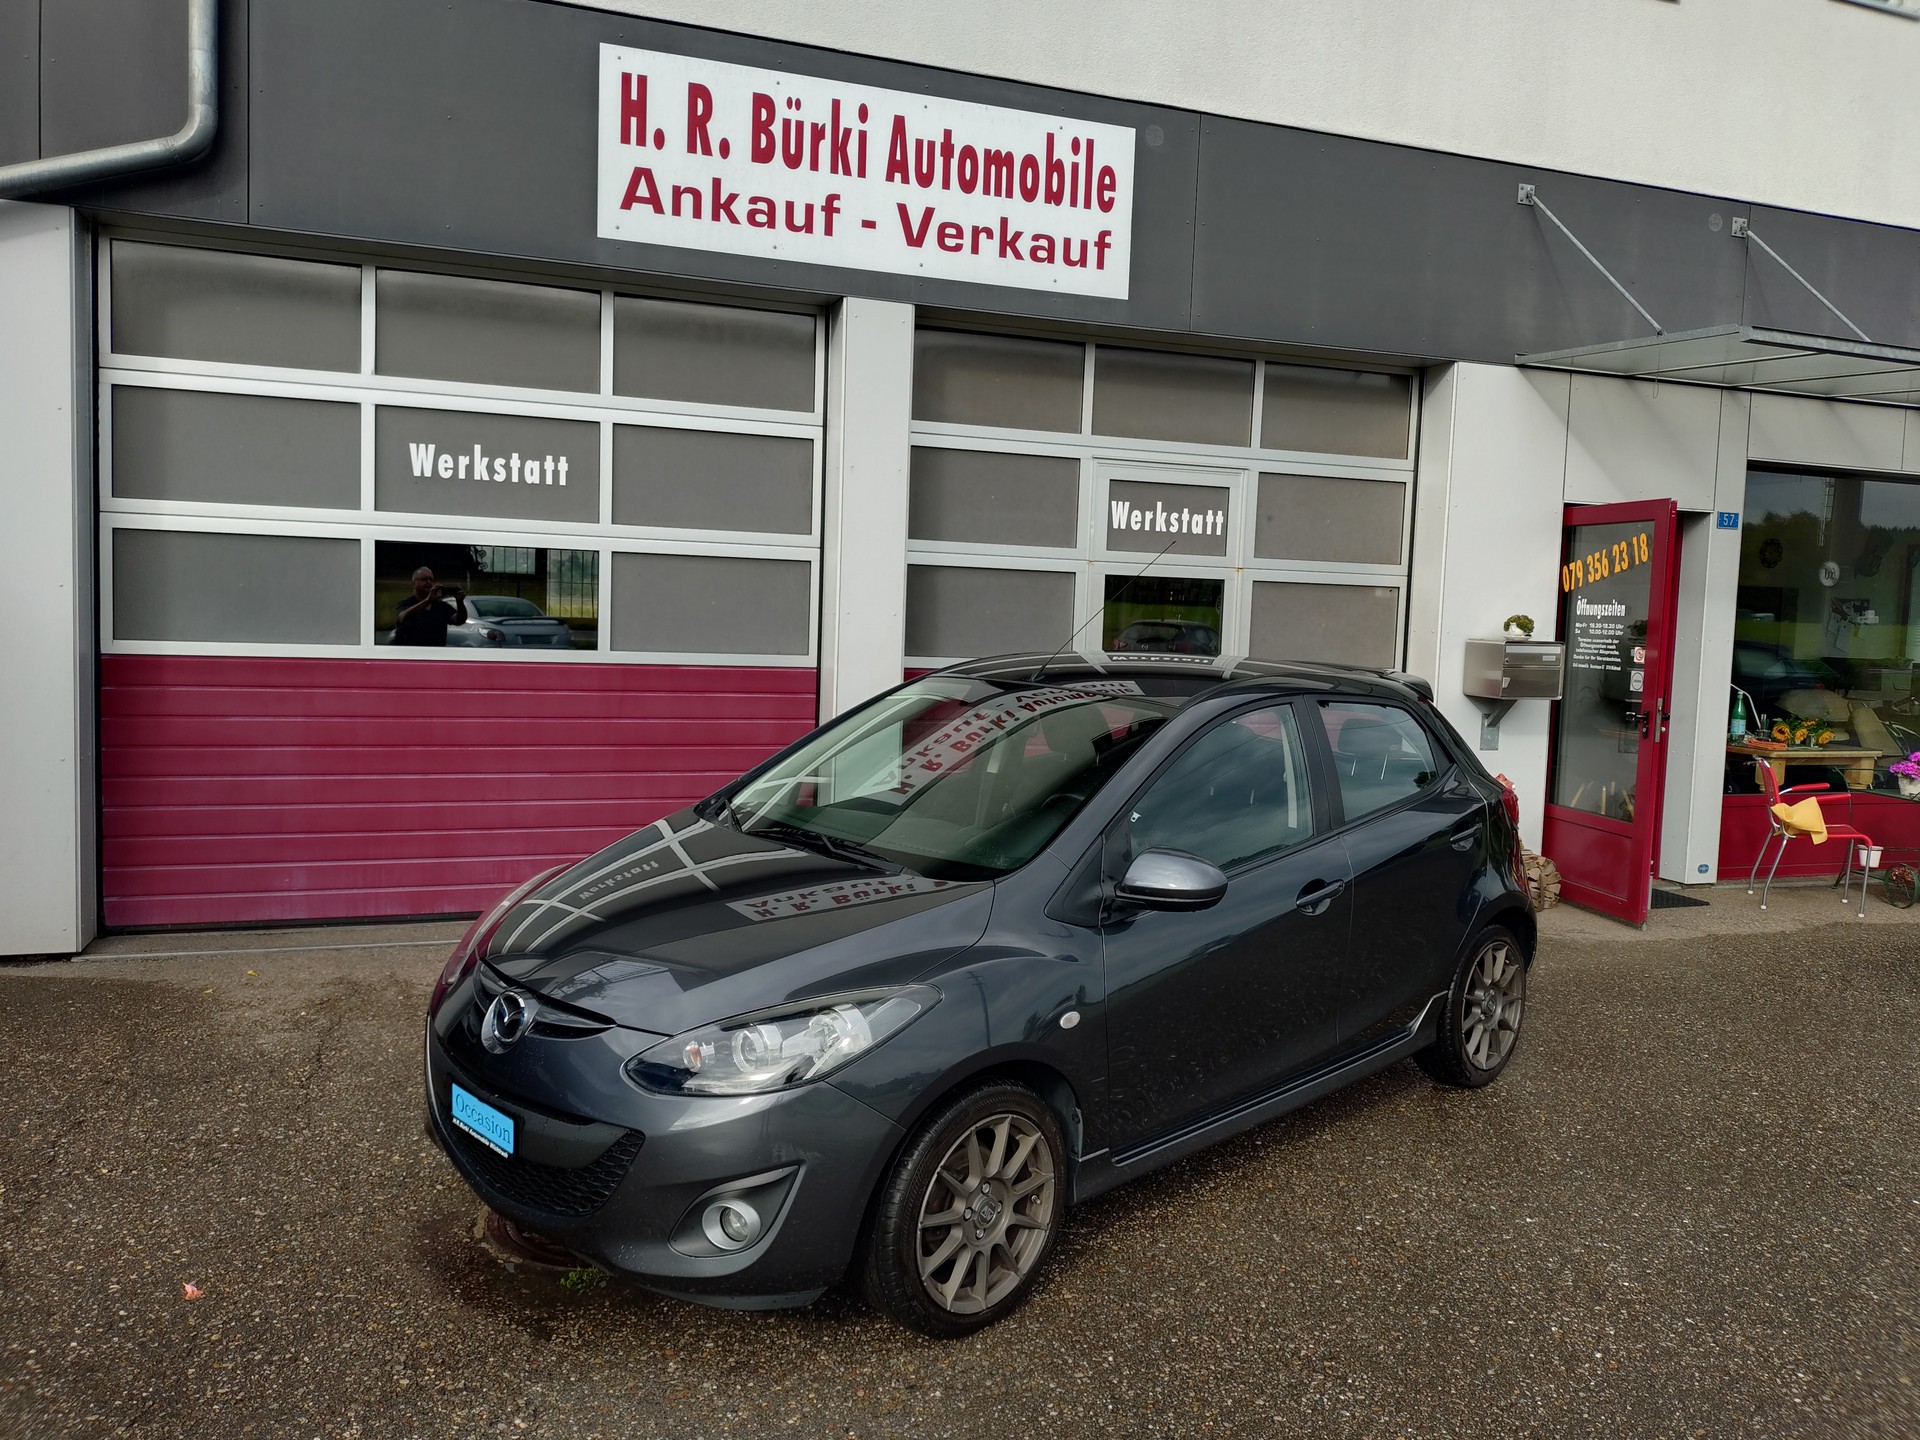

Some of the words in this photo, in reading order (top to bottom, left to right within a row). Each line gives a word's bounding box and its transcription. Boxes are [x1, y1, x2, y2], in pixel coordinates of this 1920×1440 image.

[620, 71, 665, 150] H.
[687, 82, 730, 160] R.
[751, 91, 868, 178] Bürki
[885, 114, 1116, 213] Automobile
[619, 165, 841, 236] Ankauf
[896, 202, 1112, 270] Verkauf
[409, 443, 568, 486] Werkstatt
[1111, 501, 1224, 535] Werkstatt
[1723, 514, 1735, 526] 57
[1563, 559, 1583, 592] 079
[1587, 549, 1609, 583] 356
[1613, 541, 1629, 573] 23
[1633, 532, 1649, 565] 18
[1576, 596, 1626, 619] Öffnungszeiten
[456, 1093, 511, 1144] Occasion
